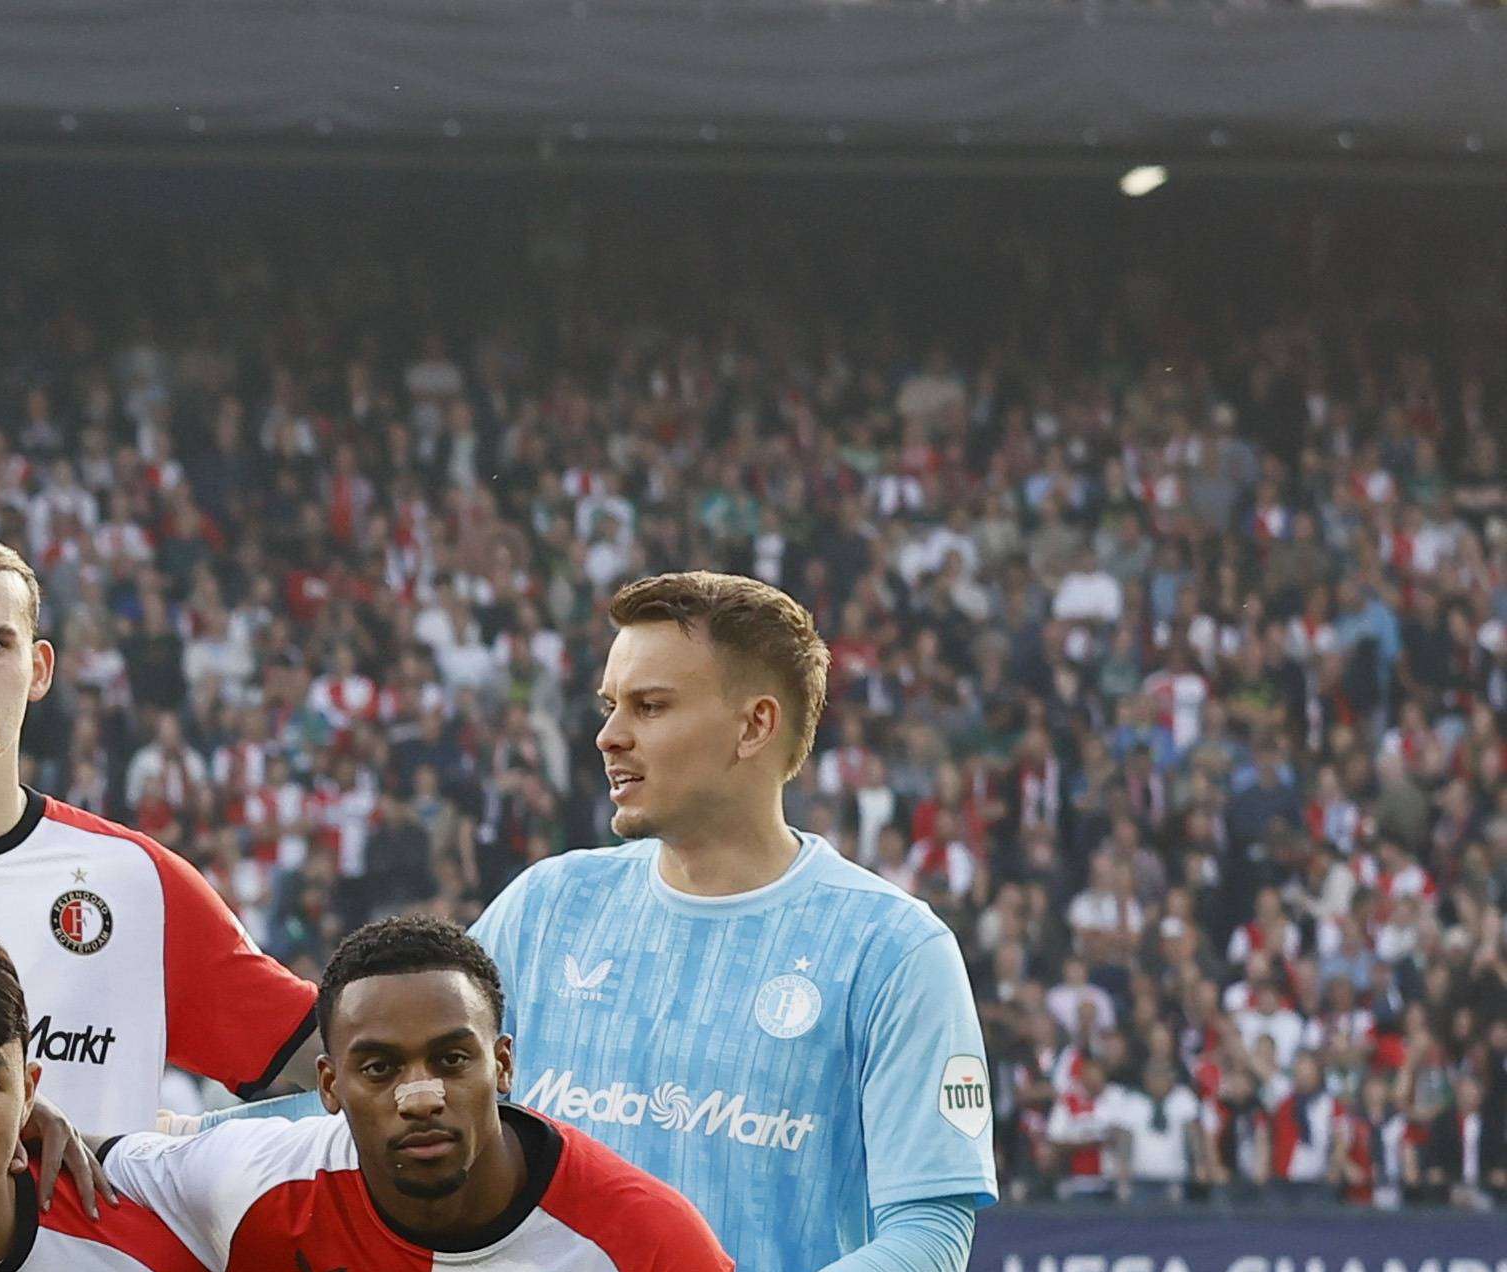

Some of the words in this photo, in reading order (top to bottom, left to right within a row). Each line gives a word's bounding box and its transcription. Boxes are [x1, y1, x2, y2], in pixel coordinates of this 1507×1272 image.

[68, 906, 93, 936] F
[523, 1068, 647, 1126] Media
[686, 1089, 815, 1151] Markt
[943, 1083, 985, 1110] TOTO
